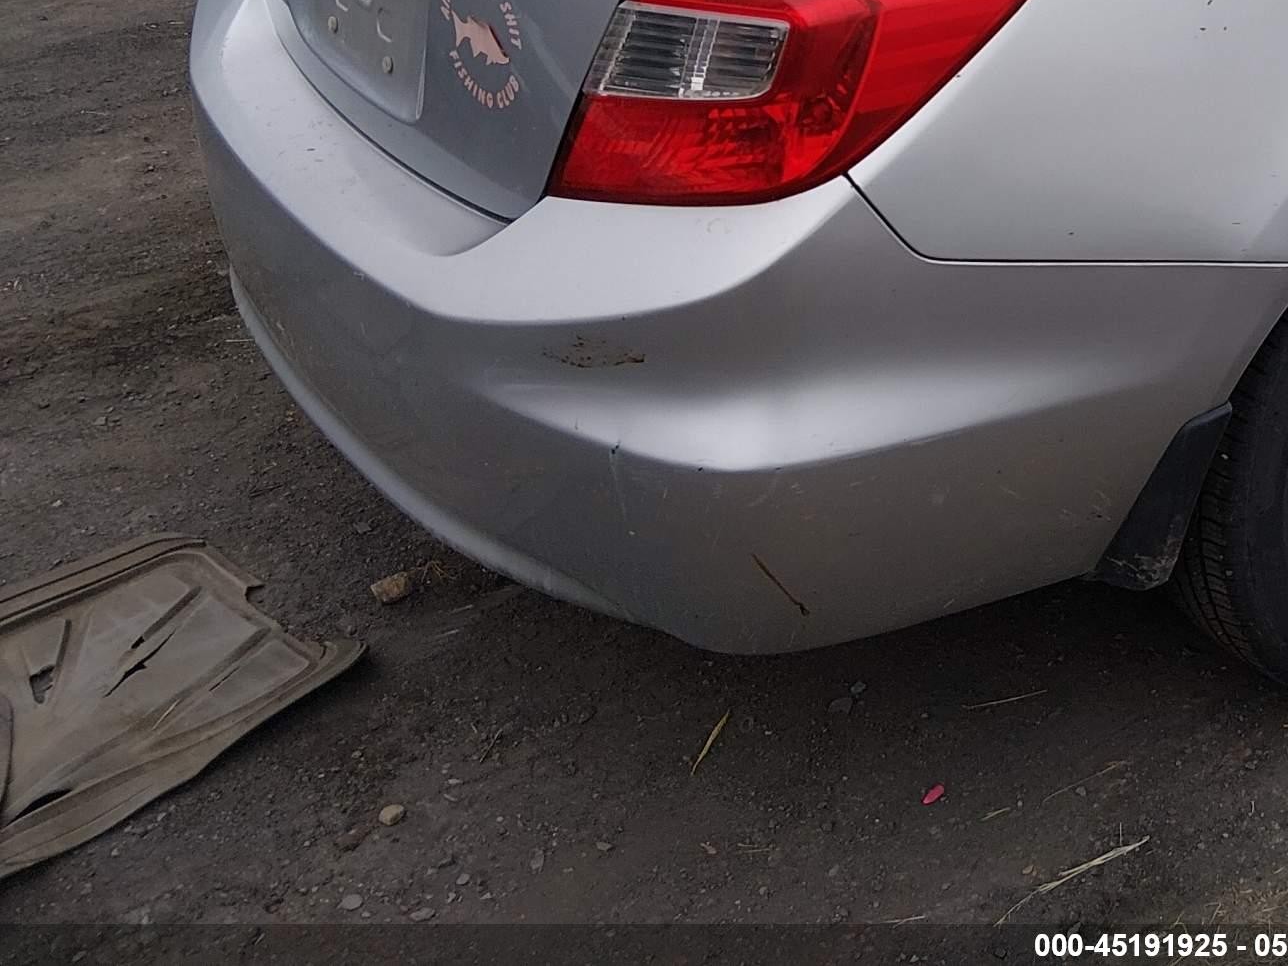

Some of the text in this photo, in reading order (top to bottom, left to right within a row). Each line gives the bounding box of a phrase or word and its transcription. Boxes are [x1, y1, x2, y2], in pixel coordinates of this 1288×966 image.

[499, 1, 522, 51] SHIT
[449, 49, 520, 109] FISHING CLUB
